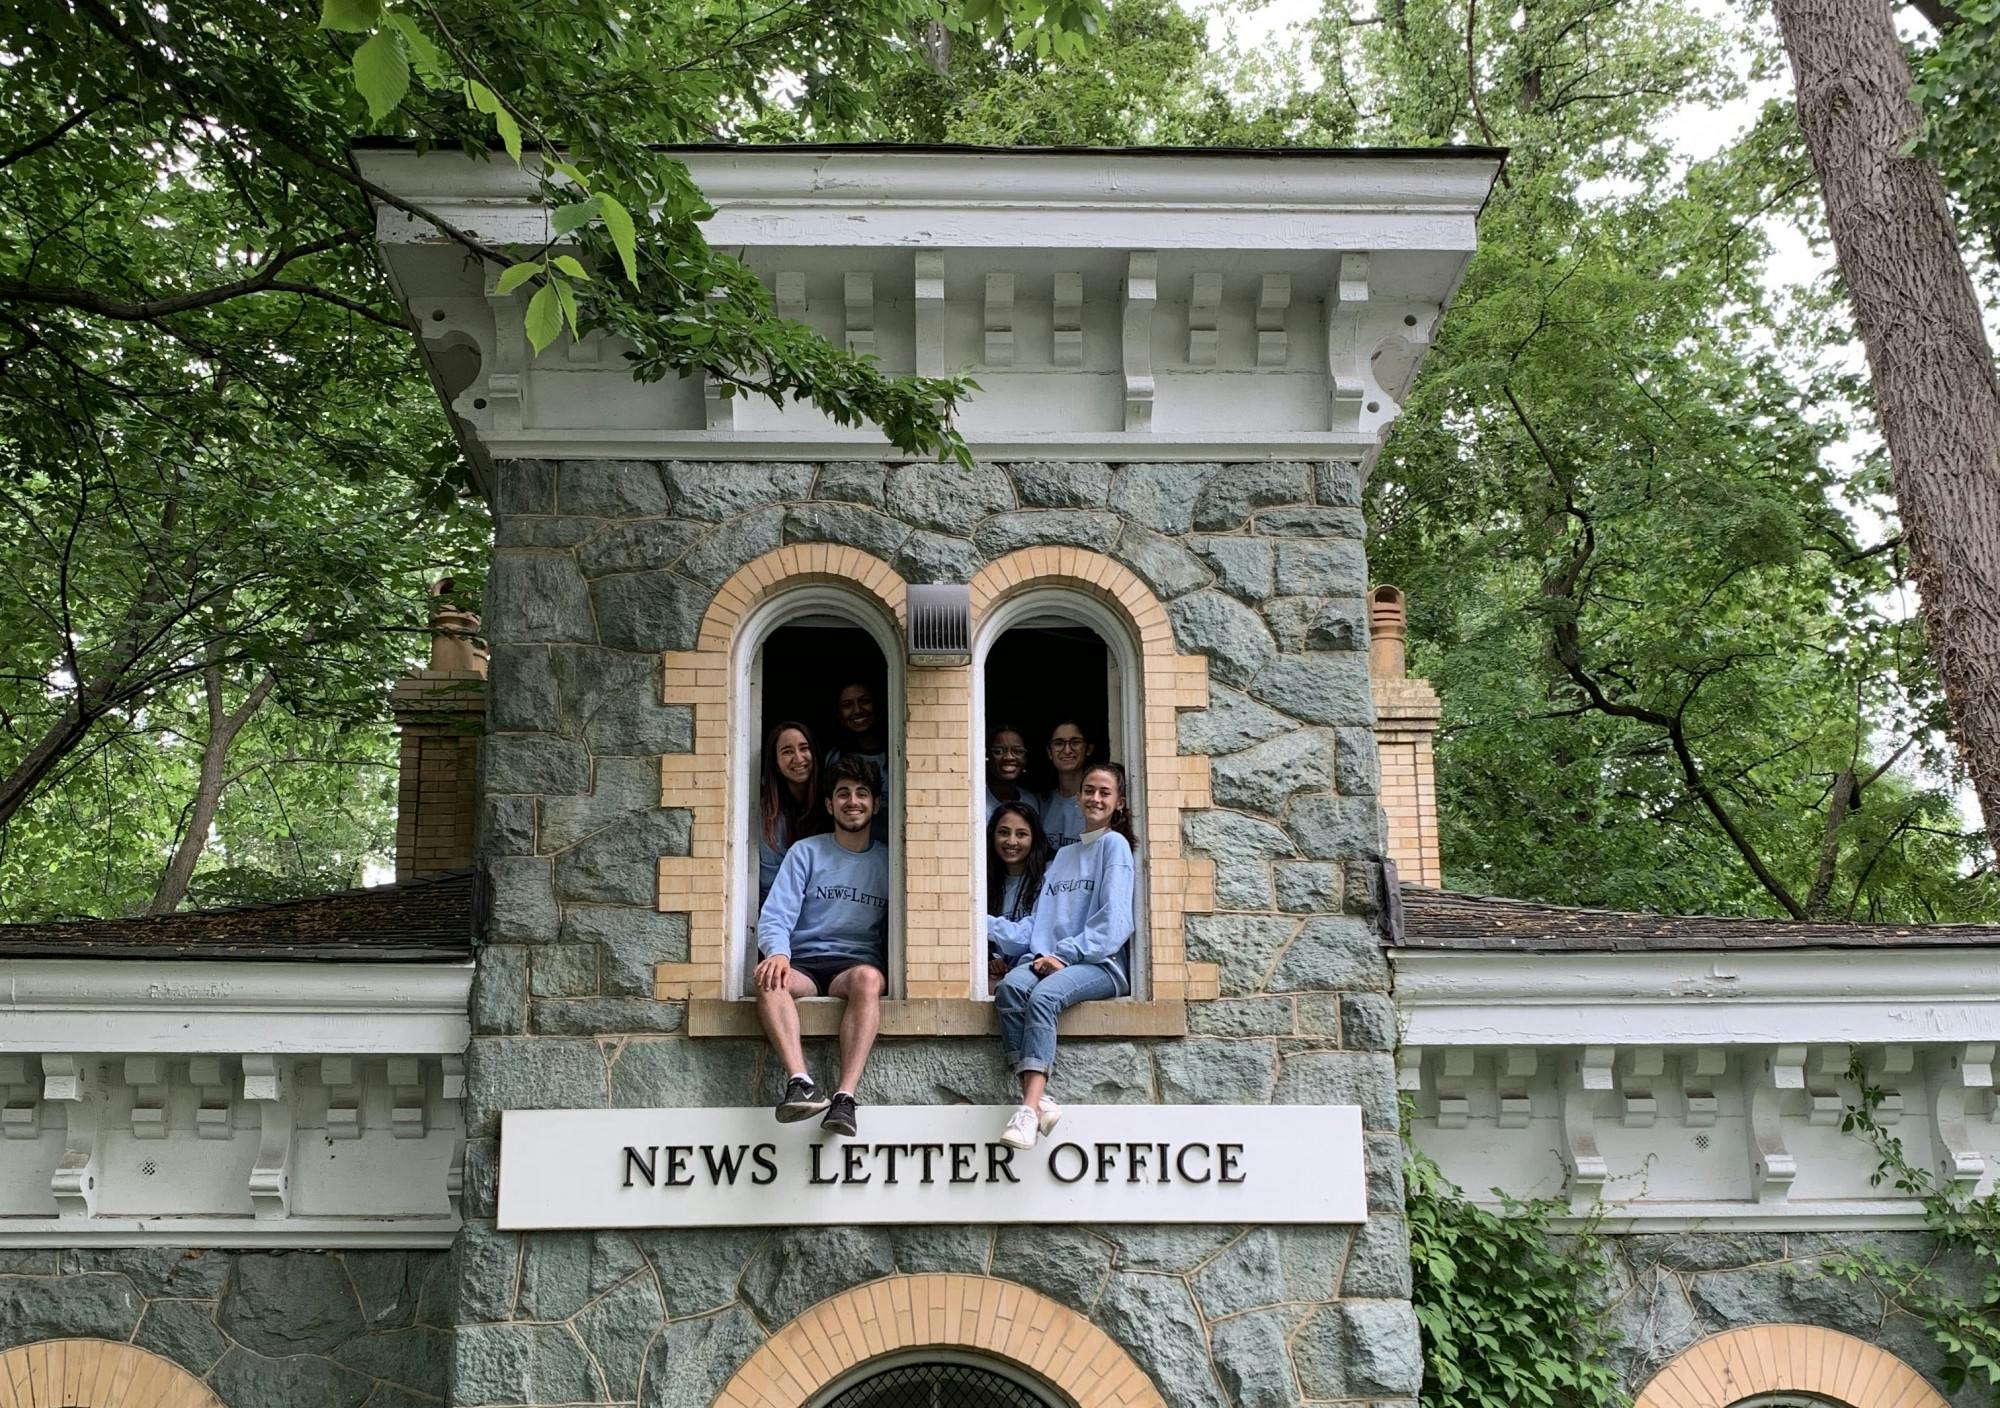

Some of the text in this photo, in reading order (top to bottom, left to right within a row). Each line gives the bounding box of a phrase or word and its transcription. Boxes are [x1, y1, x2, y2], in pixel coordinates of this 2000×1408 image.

[622, 1141, 1247, 1187] NEWS LETTER OFFICE
